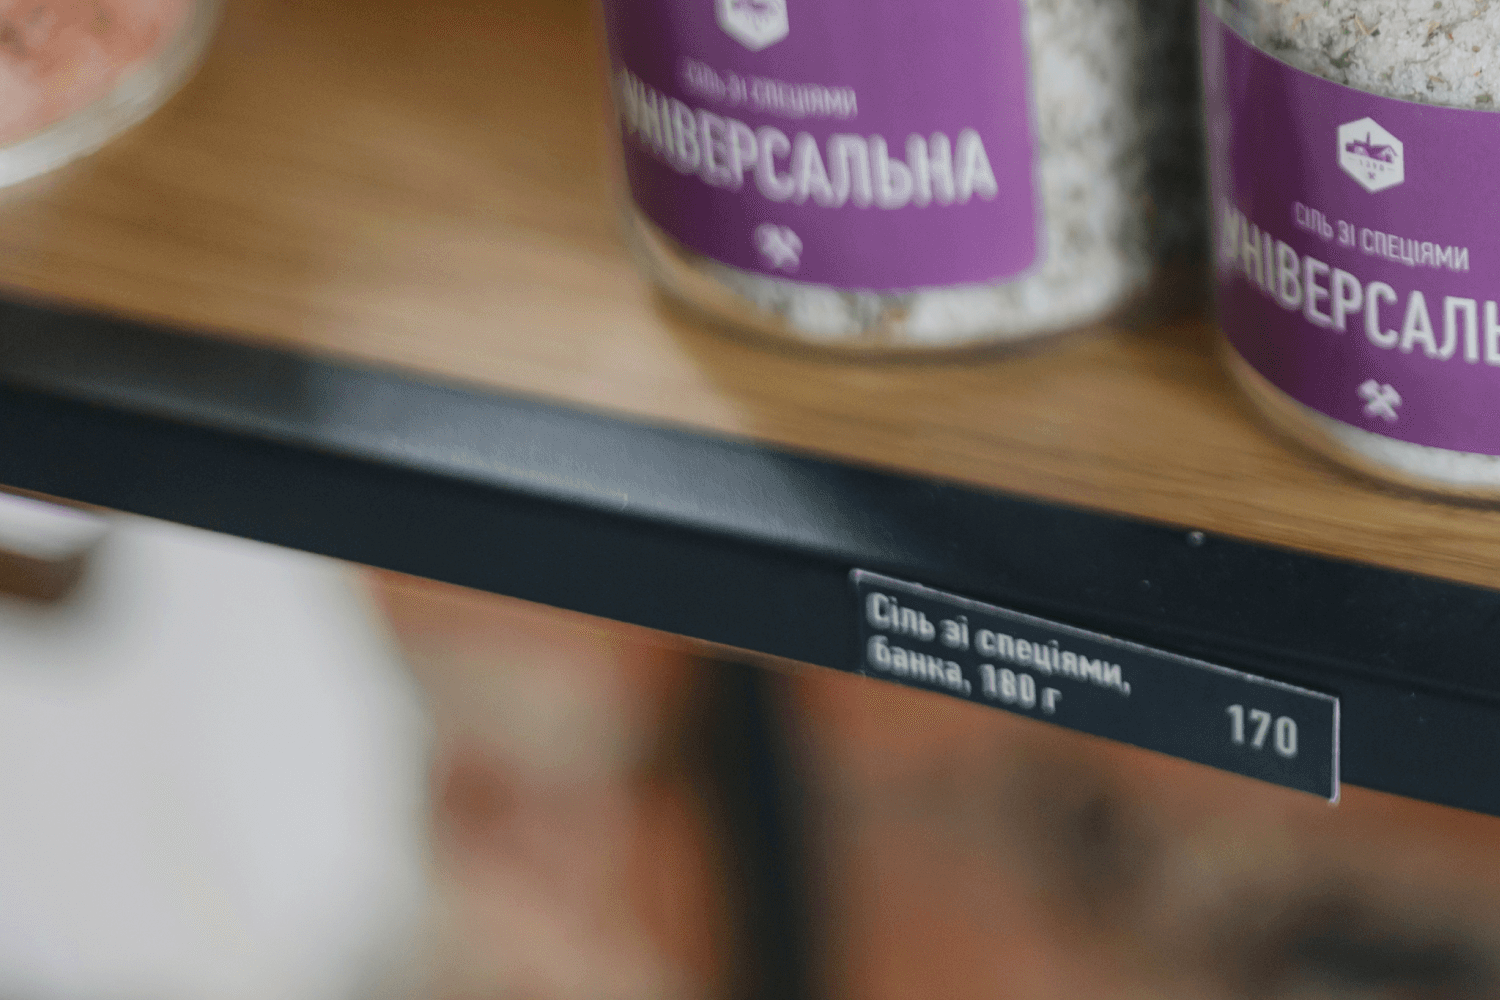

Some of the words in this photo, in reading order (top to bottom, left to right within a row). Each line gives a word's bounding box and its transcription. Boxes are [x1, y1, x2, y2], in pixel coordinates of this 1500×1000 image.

[1296, 202, 1333, 239] СІЛЬ
[1338, 220, 1355, 246] ЗІ
[1361, 227, 1469, 271] СПЕЦІЯМИ
[866, 593, 936, 642] Сіль
[940, 615, 970, 650] зі
[975, 628, 1132, 697] спеціями,
[867, 635, 972, 696] банка,
[979, 663, 1037, 709] 180
[1041, 687, 1062, 713] г
[1226, 704, 1298, 758] 170
